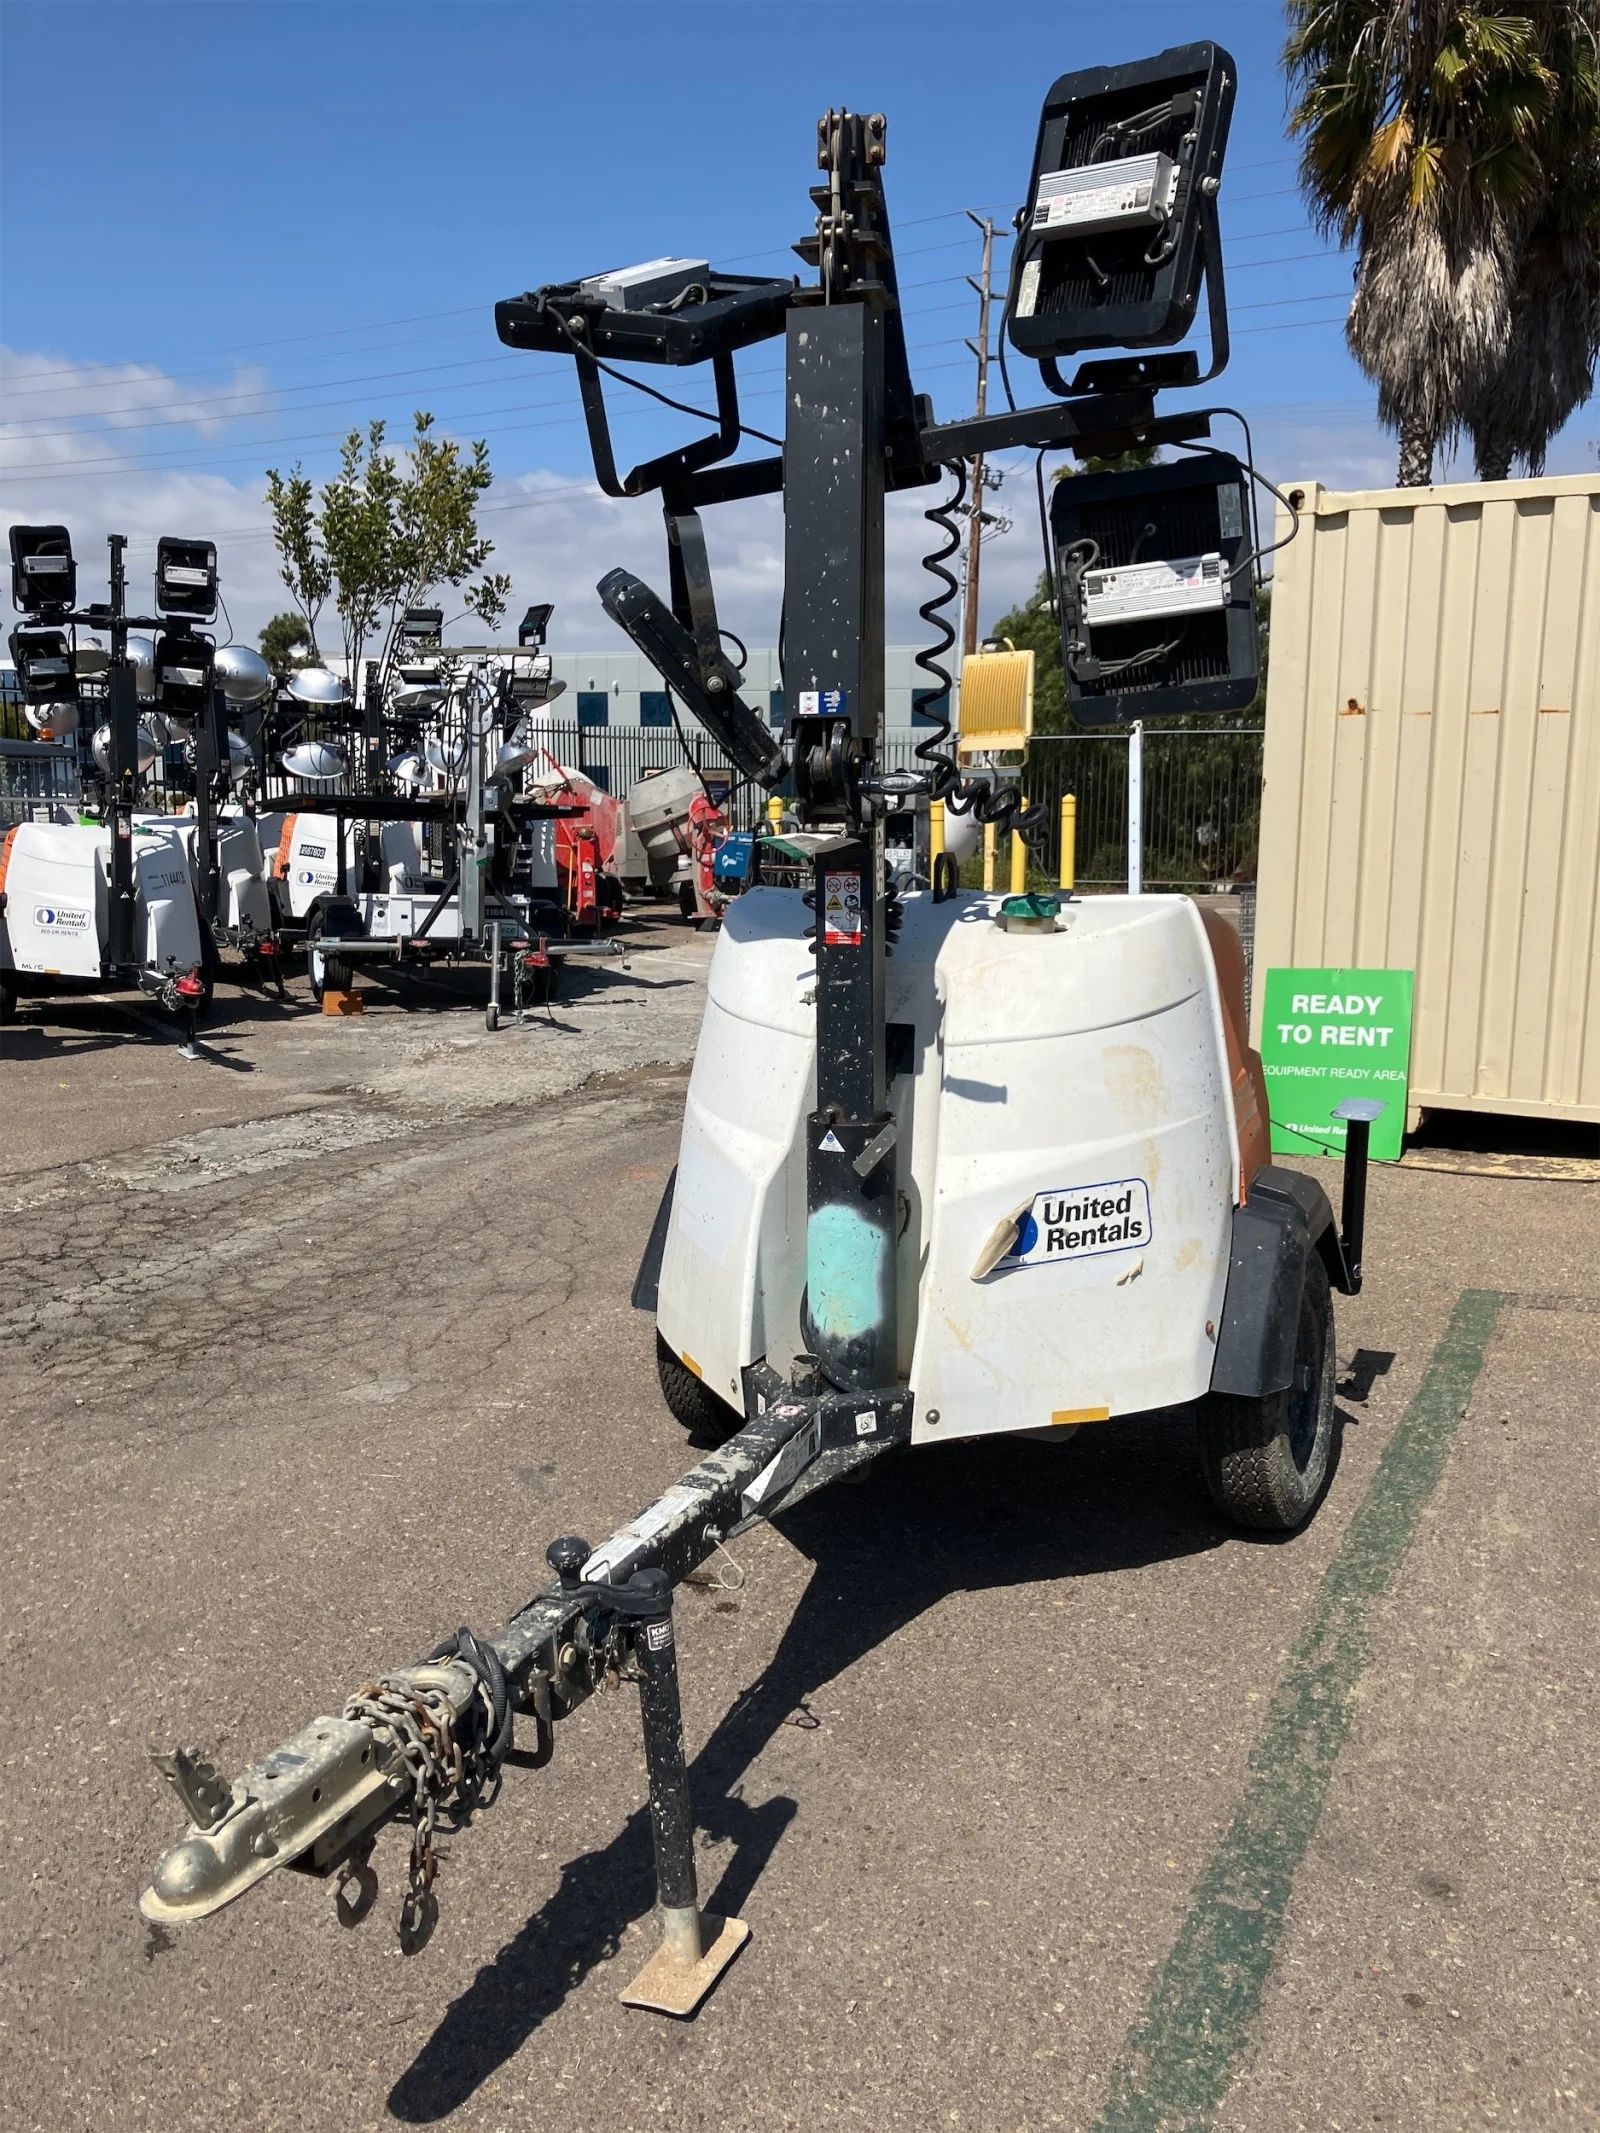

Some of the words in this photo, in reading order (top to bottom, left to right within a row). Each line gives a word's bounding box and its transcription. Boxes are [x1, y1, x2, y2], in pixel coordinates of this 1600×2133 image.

[56, 918, 87, 928] Rentals
[57, 910, 86, 920] United
[1291, 994, 1384, 1016] READY
[1277, 1024, 1312, 1044] TO
[1320, 1026, 1394, 1048] RENT
[1262, 1065, 1328, 1078] EQUIPMENT
[1330, 1067, 1371, 1079] READY
[1373, 1070, 1406, 1081] AREA
[1299, 1123, 1331, 1134] United
[1043, 1189, 1132, 1226] United
[1046, 1216, 1143, 1253] Rentals
